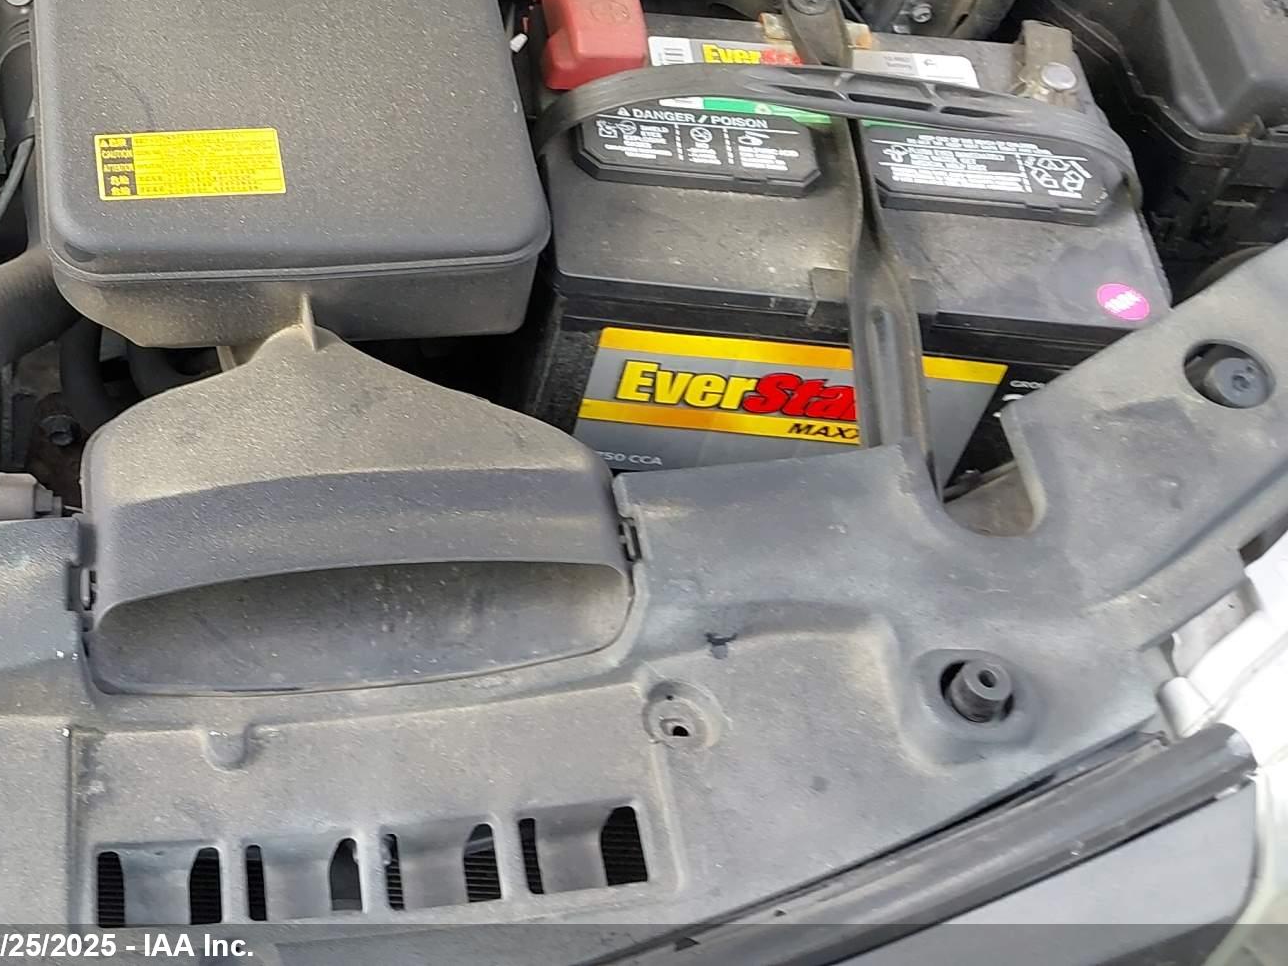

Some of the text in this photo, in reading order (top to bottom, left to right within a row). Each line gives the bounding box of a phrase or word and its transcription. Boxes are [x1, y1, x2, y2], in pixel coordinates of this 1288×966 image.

[632, 107, 696, 124] DANGER
[712, 115, 769, 129] POISON
[616, 360, 857, 422] EverSta
[629, 454, 663, 466] CCA
